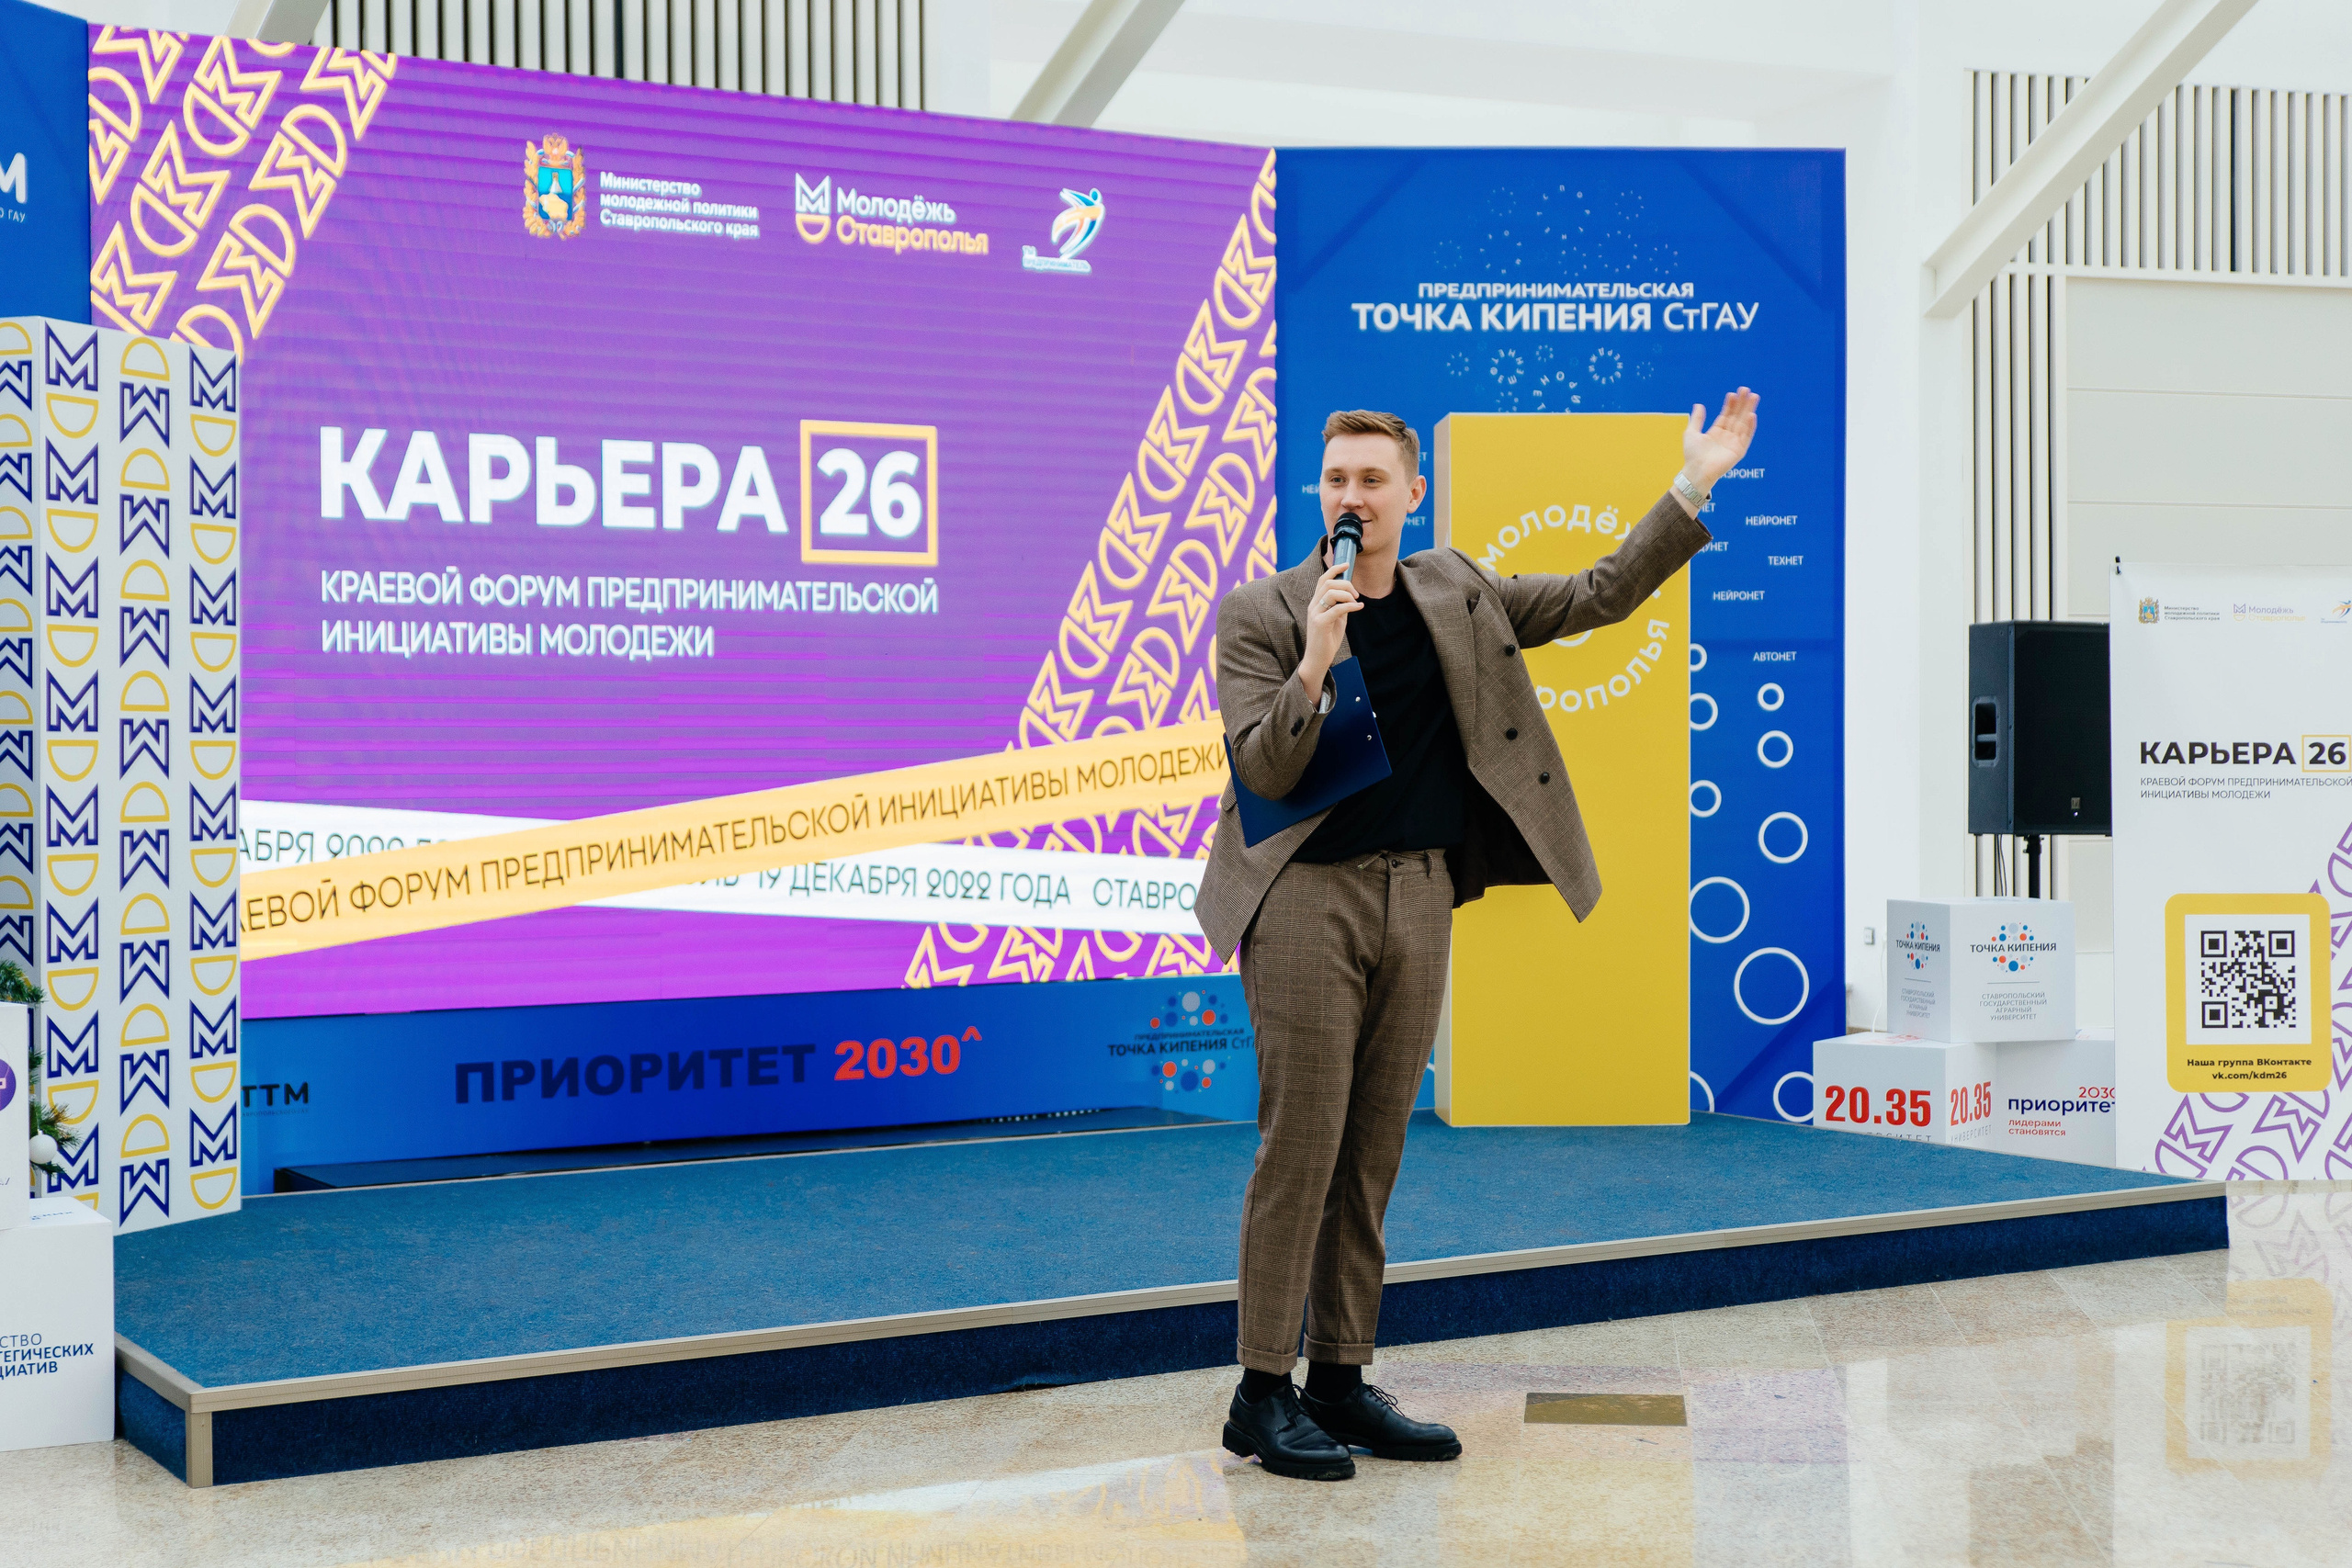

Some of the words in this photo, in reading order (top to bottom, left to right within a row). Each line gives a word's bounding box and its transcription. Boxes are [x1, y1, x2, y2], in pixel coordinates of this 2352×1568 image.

[600, 171, 702, 197] Министерство
[600, 193, 690, 213] молодежной
[693, 201, 759, 220] политики
[837, 186, 956, 225] Молодёжь
[600, 209, 724, 236] Ставропольского
[726, 221, 760, 241] края
[836, 215, 989, 255] Ставрополья
[1418, 282, 1694, 300] ПРЕДПРИНИМАТЕЛЬСКАЯ
[1351, 302, 1472, 332] ТОЧКА
[1481, 302, 1652, 332] КИПЕНИЯ
[1662, 301, 1759, 333] СтГАУ
[320, 425, 790, 534] КАРЬЕРА
[816, 446, 922, 538] 26
[1746, 514, 1798, 525] НЕЙРОНЕТ
[1768, 555, 1804, 566] ТЕХНЕТ
[321, 566, 461, 606] КРАЕВОЙ
[469, 571, 579, 608] ФОРУМ
[588, 577, 938, 614] ПРЕДПРИНИМАТЕЛЬСКОЙ
[1713, 589, 1765, 601] НЕЙРОНЕТ
[2248, 605, 2293, 615] Молодёжь
[2248, 614, 2306, 622] Ставрополья
[321, 620, 532, 658] ИНИЦИАТИВЫ
[539, 622, 714, 660] МОЛОДЕЖИ
[1753, 650, 1797, 662] АВТОНЕТ
[2140, 741, 2297, 765] КАРЬЕРА
[2308, 741, 2347, 765] 26
[2140, 775, 2186, 786] КРАЕВОЙ
[2188, 776, 2225, 786] ФОРУМ
[2227, 776, 2352, 787] ПРЕДПРИНИМАТЕЛЬСКОЙ
[2140, 790, 2210, 799] ИНИЦИАТИВЫ
[2211, 790, 2272, 799] МОЛОДЕЖИ
[240, 878, 339, 932] ЕВОЙ
[349, 864, 470, 913] ФОРУМ
[481, 794, 870, 894] ПРЕДПРИНИМАТЕЛЬСКОЙ
[878, 766, 1070, 825] ИНИЦИАТИВЫ
[789, 862, 917, 897] ДЕКАБРЯ
[928, 868, 991, 901] 2022
[999, 873, 1070, 908] ГОДА
[1093, 878, 1196, 911] СТАВРО
[1895, 939, 1914, 950] ТОЧКА
[1915, 942, 1940, 953] КИПЕНИЯ
[1970, 943, 2005, 953] ТОЧКА
[2007, 942, 2057, 953] КИПЕНИЯ
[1980, 998, 2047, 1007] ГОСУДАРСТВЕННЫЙ
[1982, 991, 2045, 999] СТАВРОПОЛЬСКИЙ
[1990, 1013, 2037, 1021] УНИВЕРСИТЕТ
[1108, 1043, 1155, 1057] ТОЧКА
[1159, 1037, 1227, 1055] КИПЕНИЯ
[1231, 1035, 1256, 1050] СтГ
[2187, 1058, 2215, 1066] Наша
[2218, 1059, 2254, 1068] группа
[2256, 1058, 2312, 1066] ВКонтакте
[454, 1043, 817, 1104] ПРИОРИТЕТ
[2211, 1070, 2288, 1080] vk.com/kdm26
[1825, 1085, 1932, 1127] 20.35
[1950, 1080, 1992, 1127] 20.35
[2007, 1119, 2062, 1128] лидерами
[2007, 1128, 2066, 1136] становятся
[0, 1333, 42, 1348] СТВО
